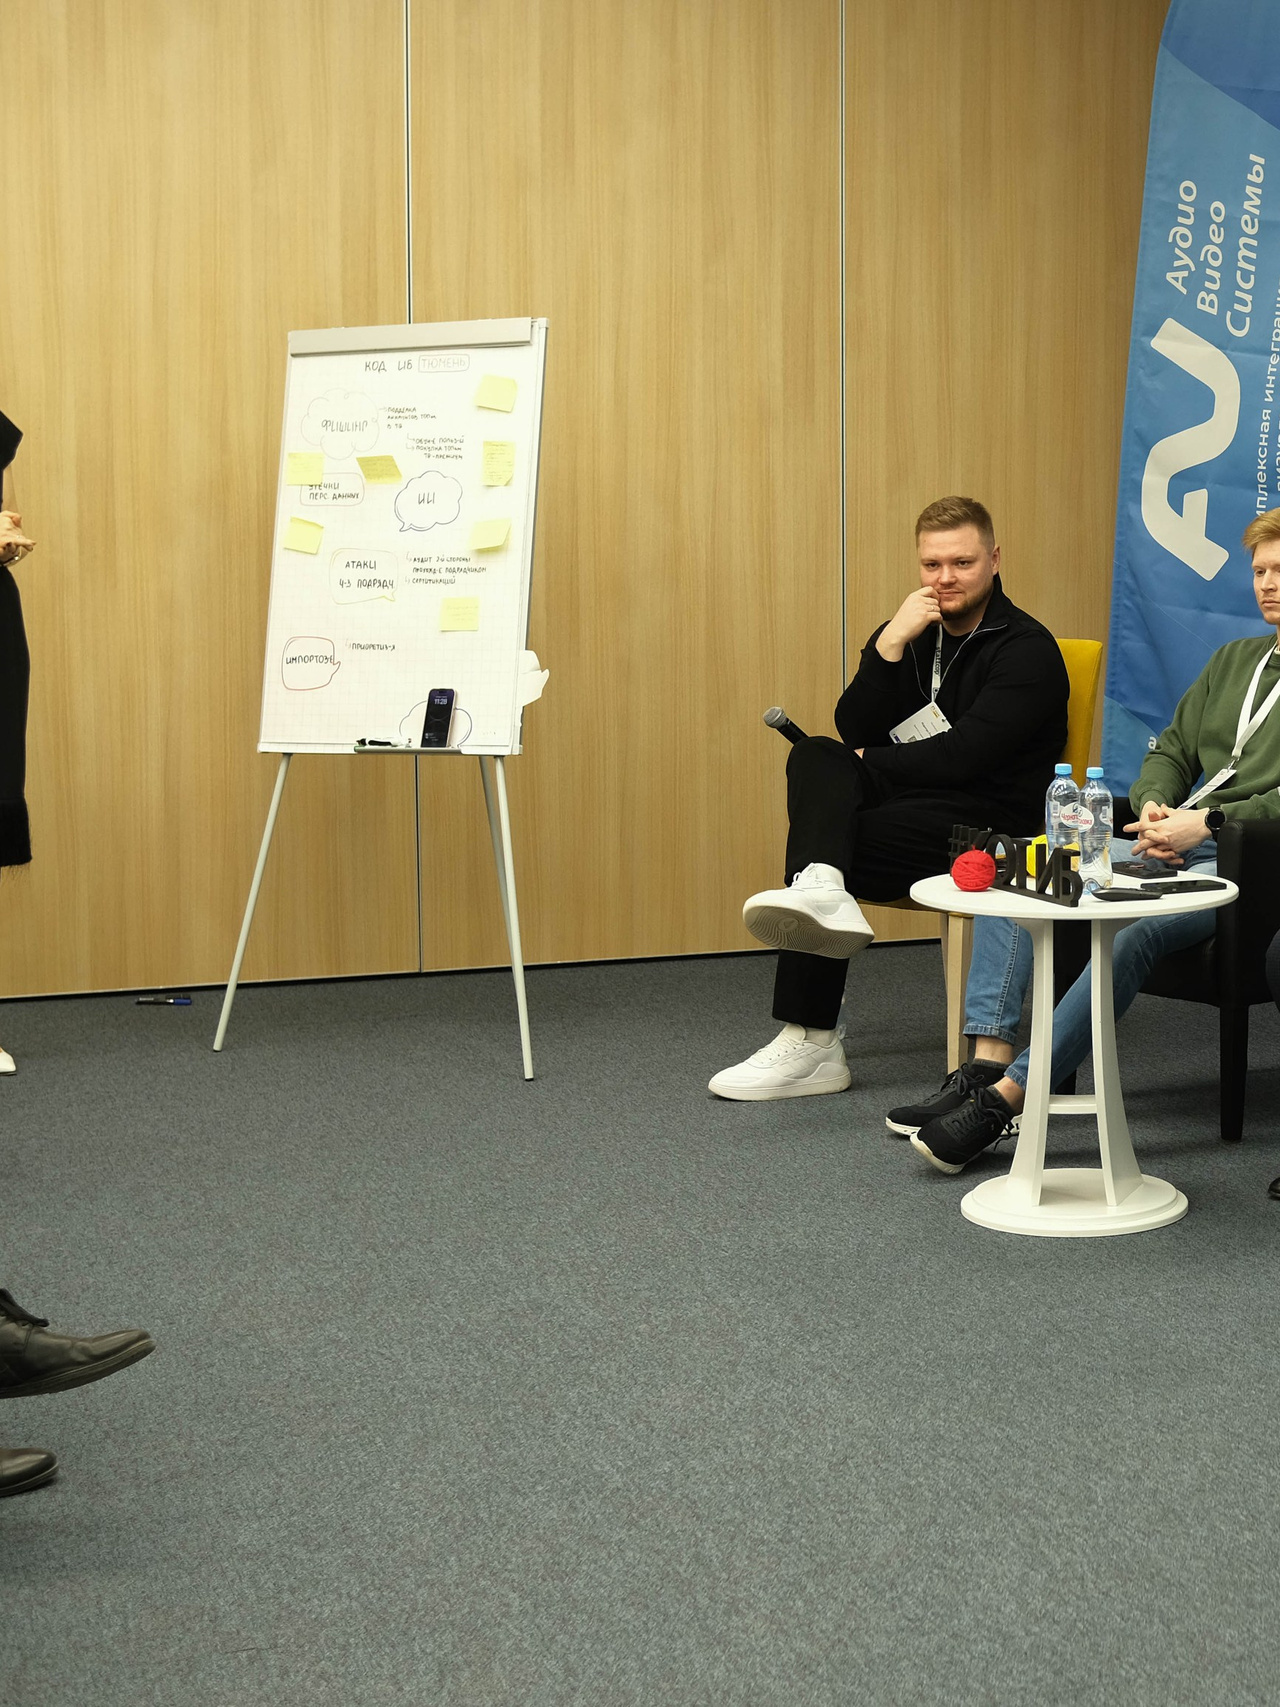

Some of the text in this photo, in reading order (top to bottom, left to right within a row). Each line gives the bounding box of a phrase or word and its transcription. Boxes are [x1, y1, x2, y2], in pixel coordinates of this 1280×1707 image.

[1165, 180, 1197, 295] Аудио
[1197, 201, 1226, 316] Видео
[1225, 153, 1265, 338] Системы
[365, 358, 466, 374] КОД ИБ ТЮМЕНЬ
[345, 560, 377, 570] АТАКИ
